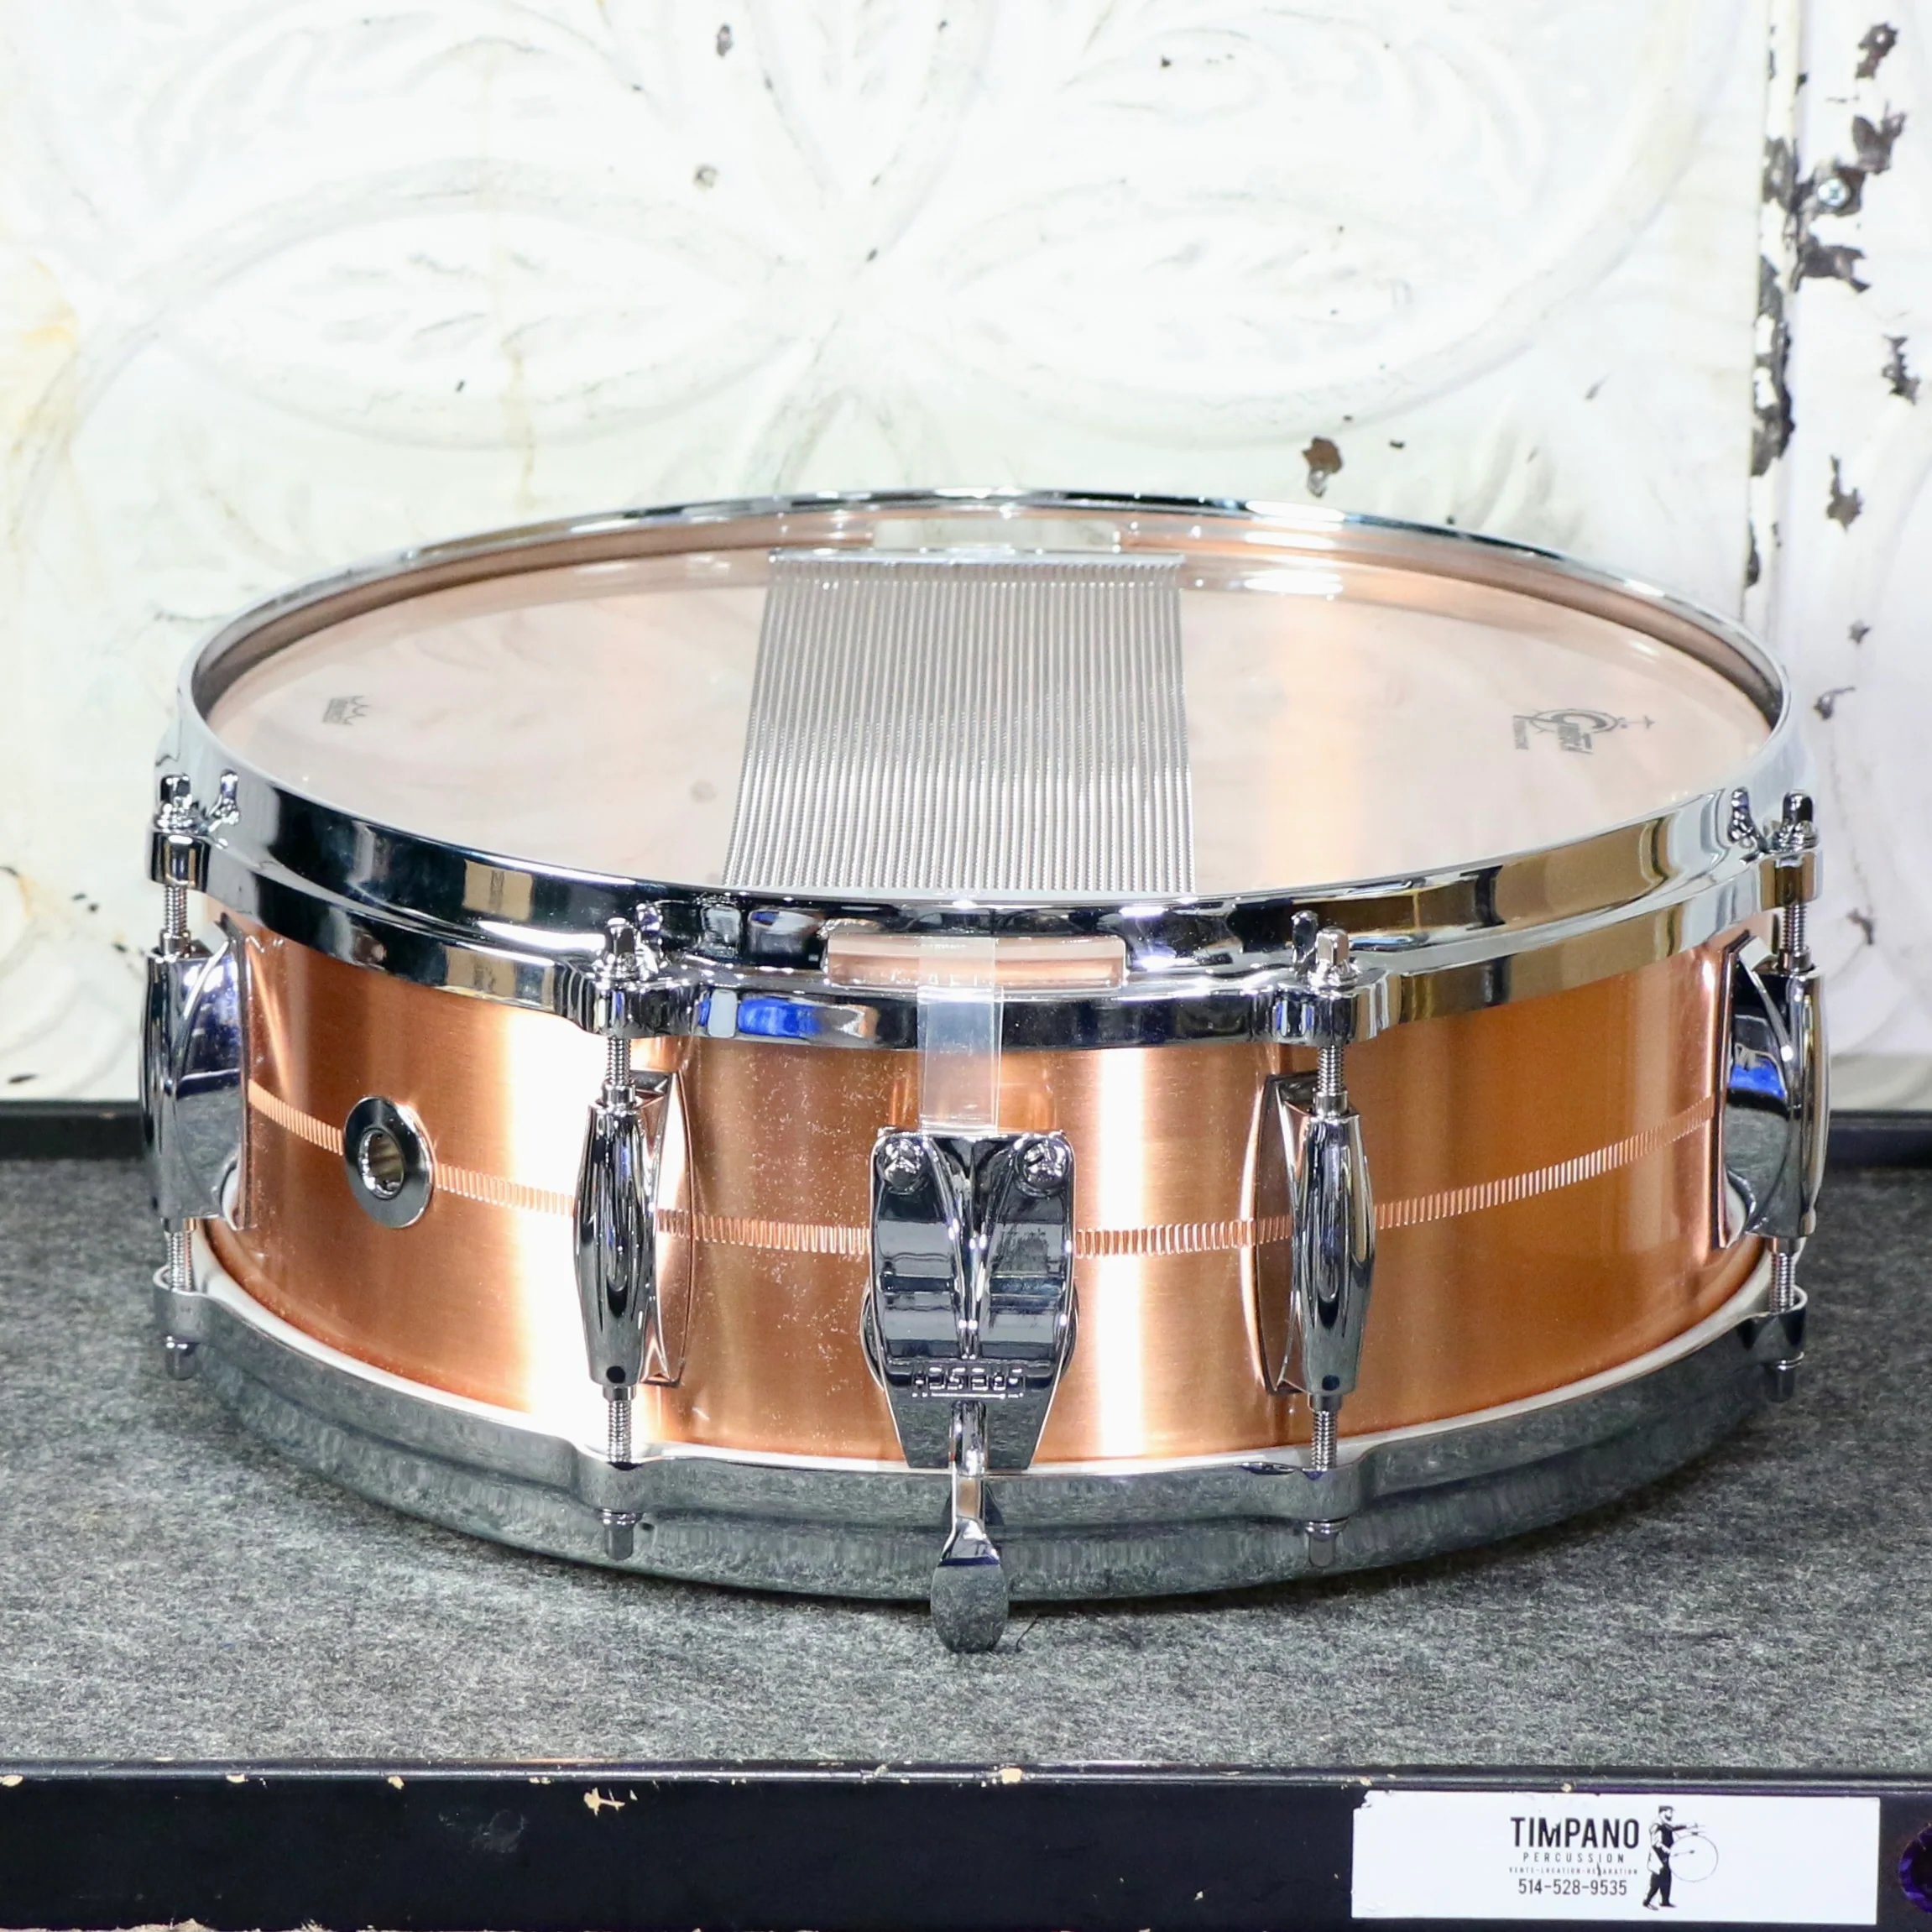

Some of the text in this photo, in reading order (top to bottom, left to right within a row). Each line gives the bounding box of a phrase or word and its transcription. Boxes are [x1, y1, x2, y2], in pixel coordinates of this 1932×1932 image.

[1510, 1817, 1640, 1849] TIMPANO
[1523, 1852, 1625, 1863] PERCUSSION
[1518, 1878, 1627, 1896] 514-528-9535
